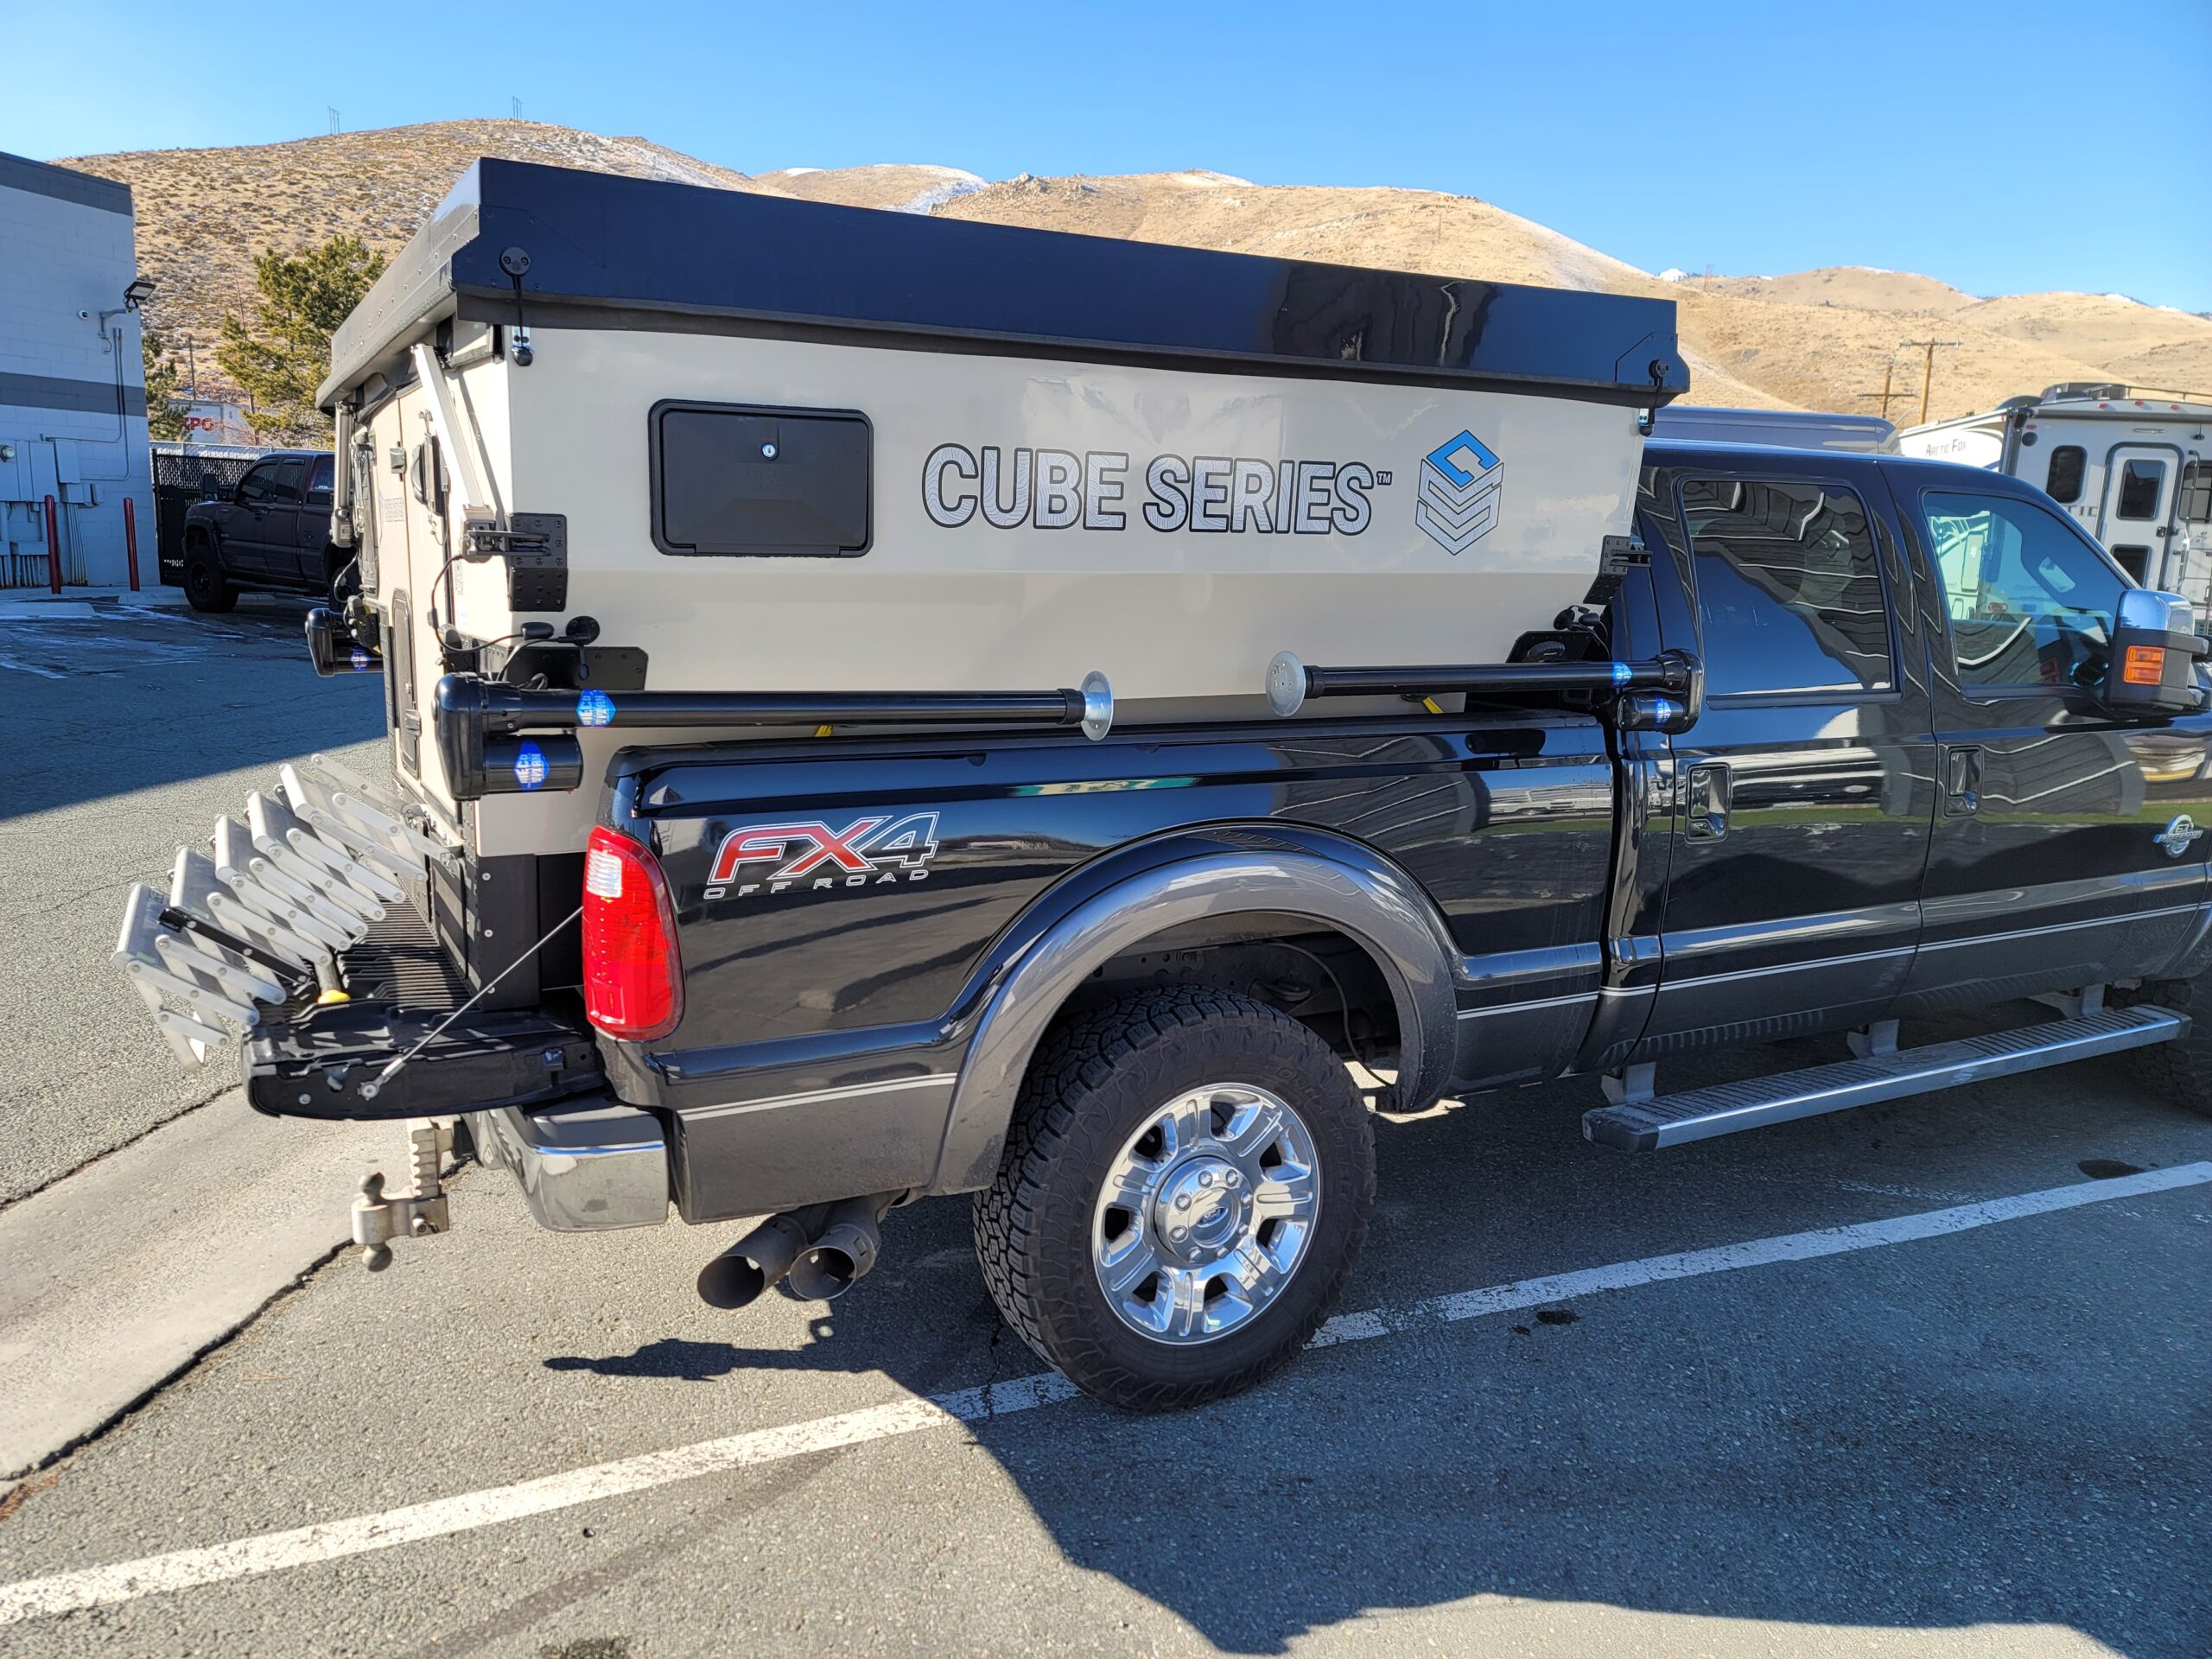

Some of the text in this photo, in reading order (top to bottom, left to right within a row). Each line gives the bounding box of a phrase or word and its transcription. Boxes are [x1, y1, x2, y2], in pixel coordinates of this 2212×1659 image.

[922, 443, 1128, 531] CUBE
[1142, 454, 1374, 536] SERIES
[707, 811, 940, 886] FX4
